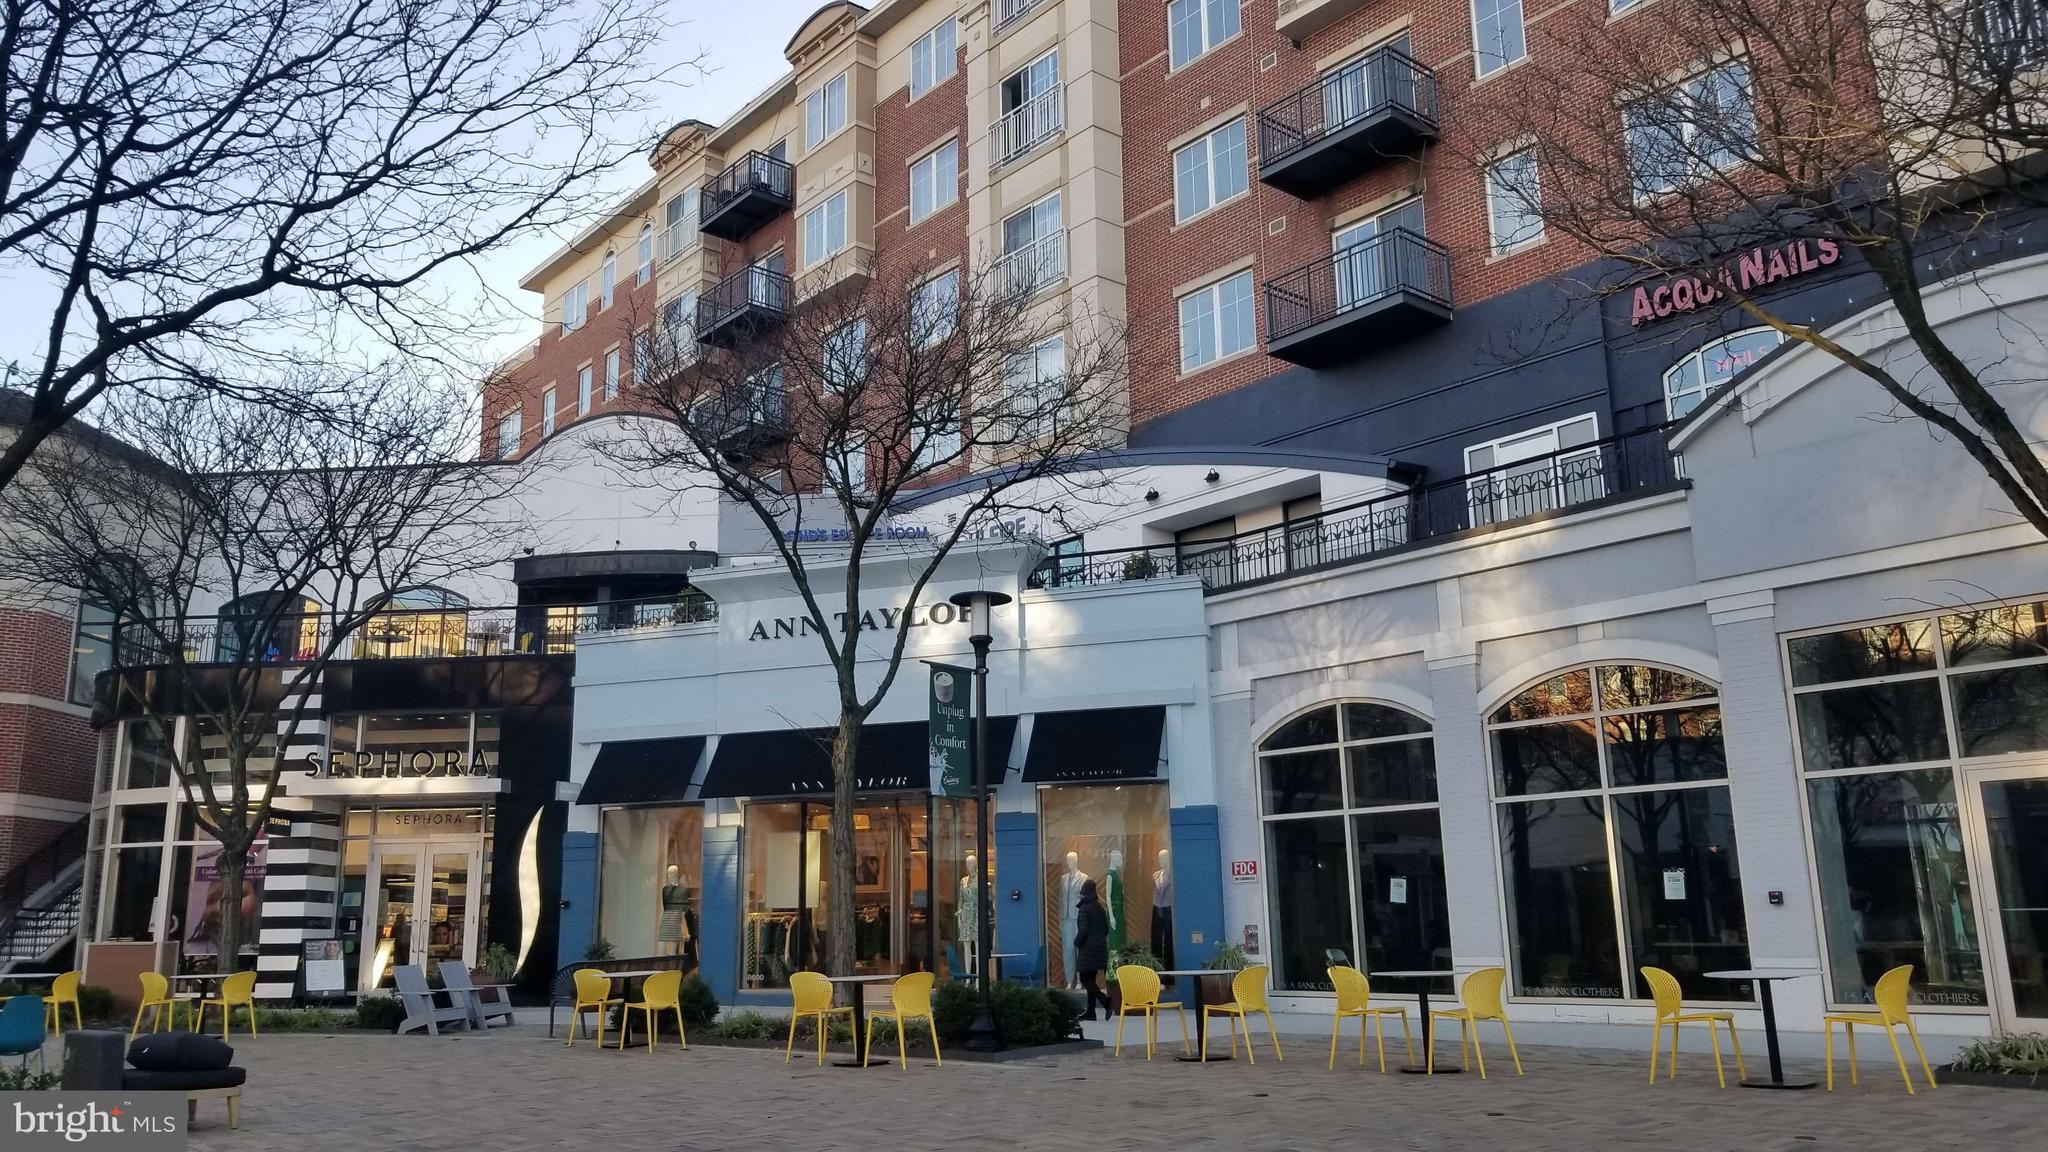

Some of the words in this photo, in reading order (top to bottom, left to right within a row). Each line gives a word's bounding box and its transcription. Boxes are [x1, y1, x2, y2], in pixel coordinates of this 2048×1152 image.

[1738, 238, 1839, 290] NAILS
[831, 527, 883, 541] ESCE
[886, 526, 929, 539] ROOM
[748, 615, 821, 641] ANN
[937, 702, 965, 719] Unplug
[946, 721, 954, 732] in
[934, 734, 966, 749] Comfort
[305, 749, 491, 778] SEPHORA
[395, 814, 462, 825] SEPHORA
[1233, 862, 1255, 875] FDC
[1572, 986, 1620, 997] CLOTHIERS
[1914, 992, 1980, 1004] CLOTHIERS
